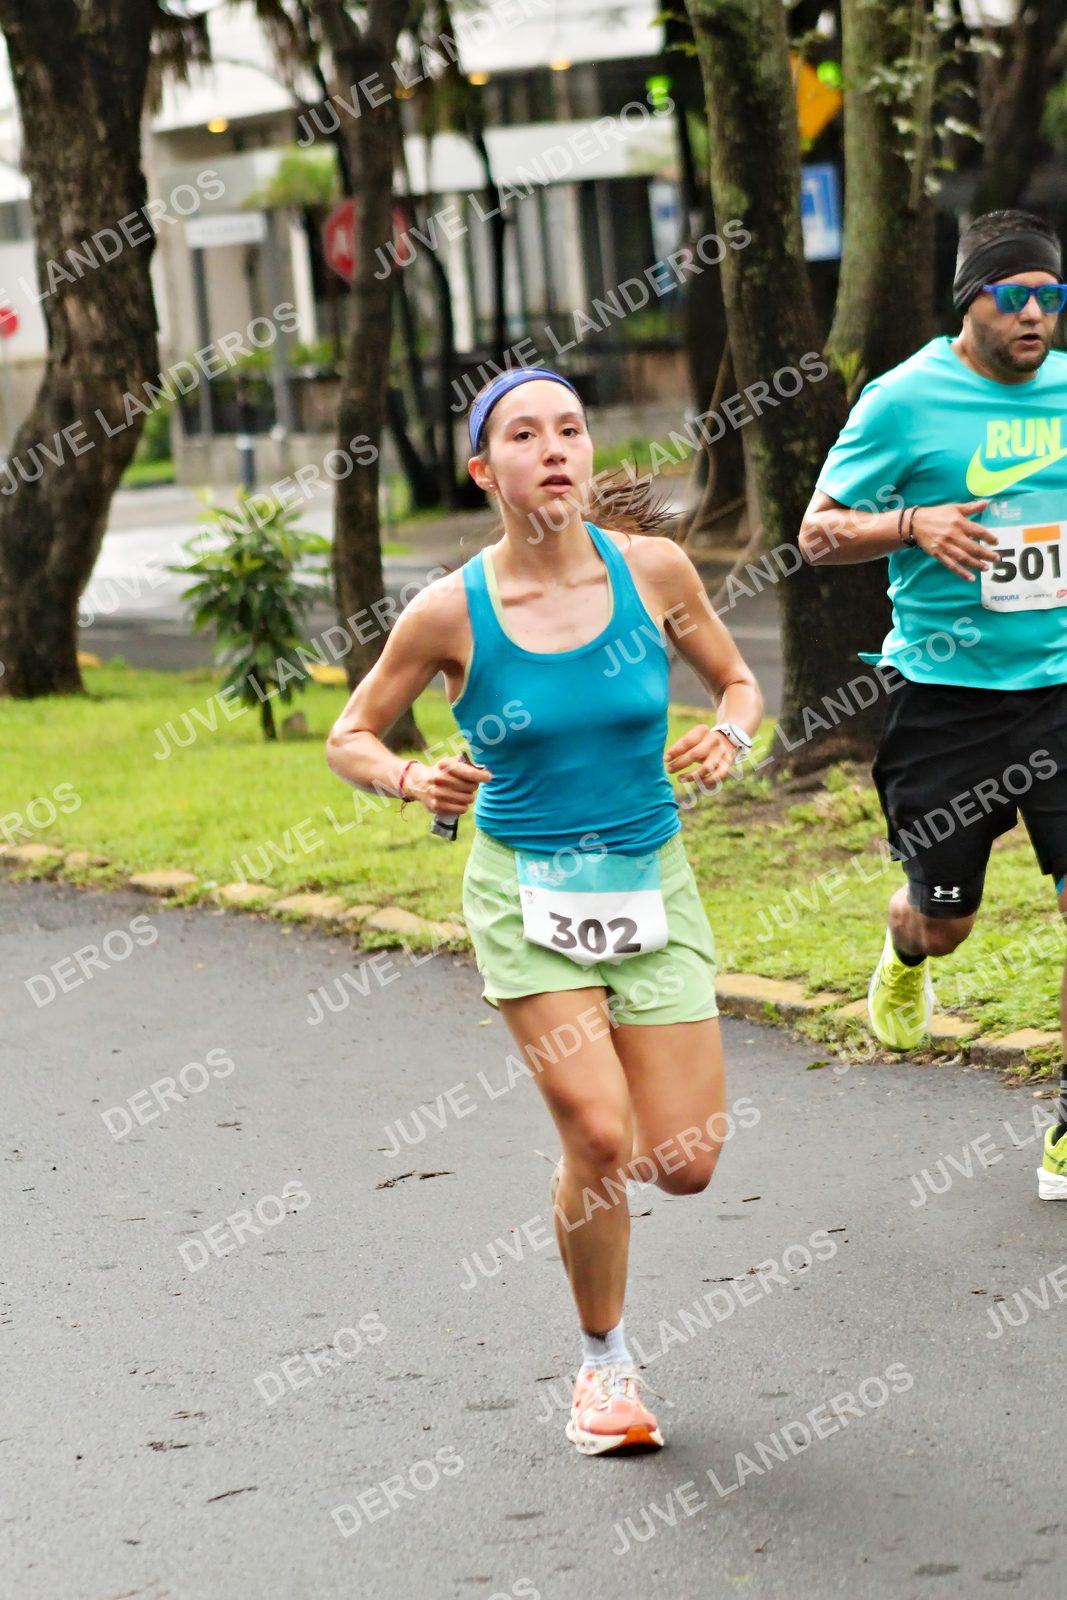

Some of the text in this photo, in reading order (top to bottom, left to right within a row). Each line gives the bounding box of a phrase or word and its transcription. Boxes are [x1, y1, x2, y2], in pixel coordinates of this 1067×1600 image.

[986, 417, 1061, 459] RUN
[991, 544, 1061, 584] 501
[549, 911, 642, 954] 302
